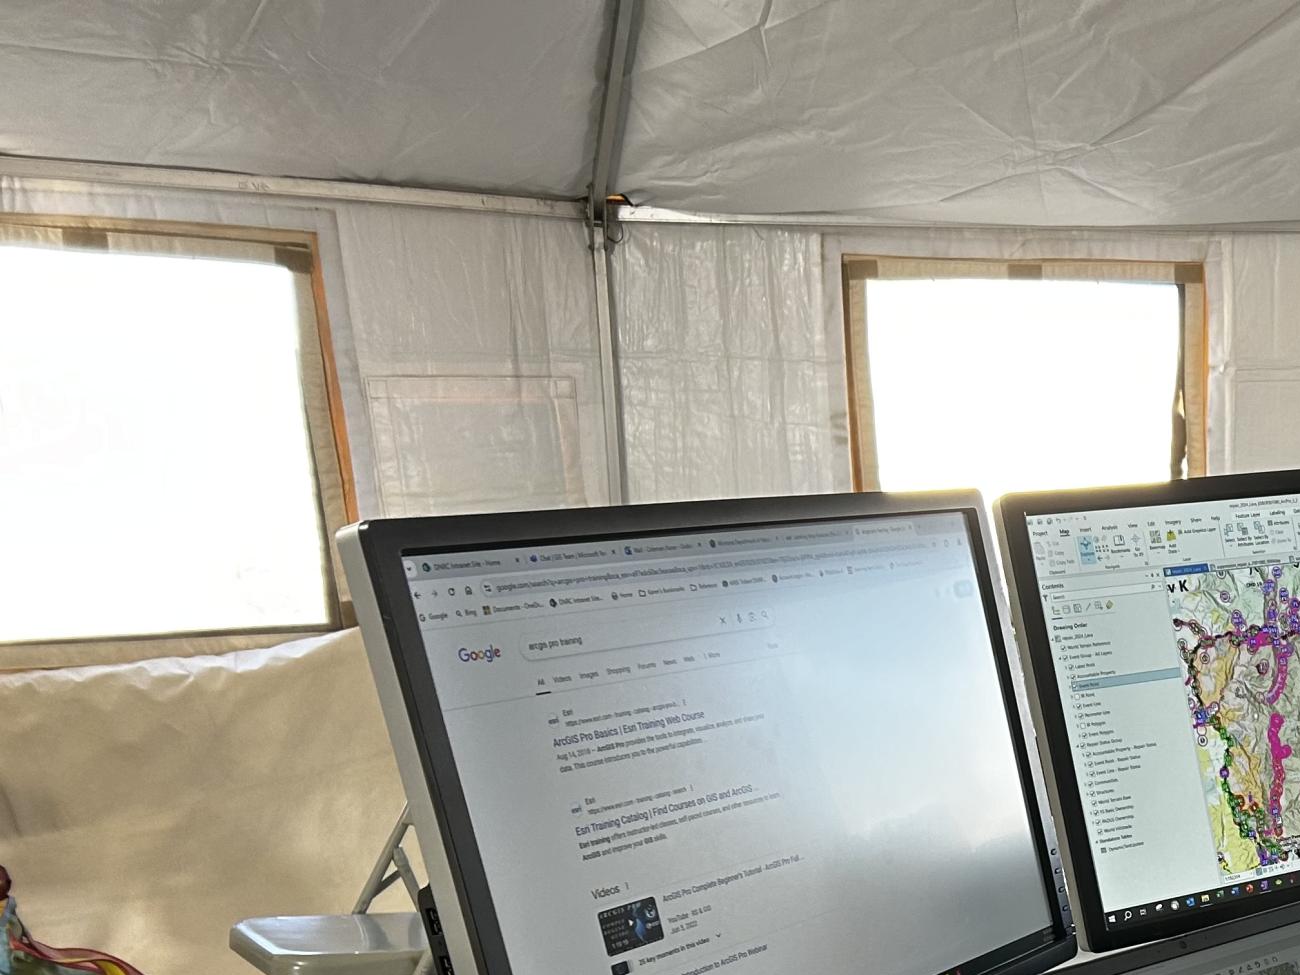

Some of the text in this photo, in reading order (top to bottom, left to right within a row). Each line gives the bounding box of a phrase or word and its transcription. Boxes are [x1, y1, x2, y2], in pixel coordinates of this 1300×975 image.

[1042, 583, 1064, 591] Contents
[1178, 580, 1188, 592] K
[560, 636, 582, 647] training
[458, 644, 501, 662] Google
[537, 665, 631, 686] All Videos Images Shopping
[553, 711, 704, 748] ArcGIS Pro Basics Esri Training Web Course
[597, 743, 615, 752] ArcGIS
[574, 762, 586, 770] This
[576, 784, 752, 837] Esri Training Catalog Find Courses on GIS and ArcGIS
[590, 834, 611, 847] training
[582, 851, 602, 862] ArcGIS
[613, 842, 632, 854] improve
[662, 856, 790, 902] ArcGIS Pro Complete Beginner's Tutorial ArcGIS Pro
[591, 883, 620, 900] Videos
[656, 948, 680, 960] moments
[696, 938, 710, 946] video
[714, 960, 720, 968] to
[720, 954, 738, 966] ArcGIS
[738, 951, 748, 960] Pro
[748, 944, 768, 956] Webinar
